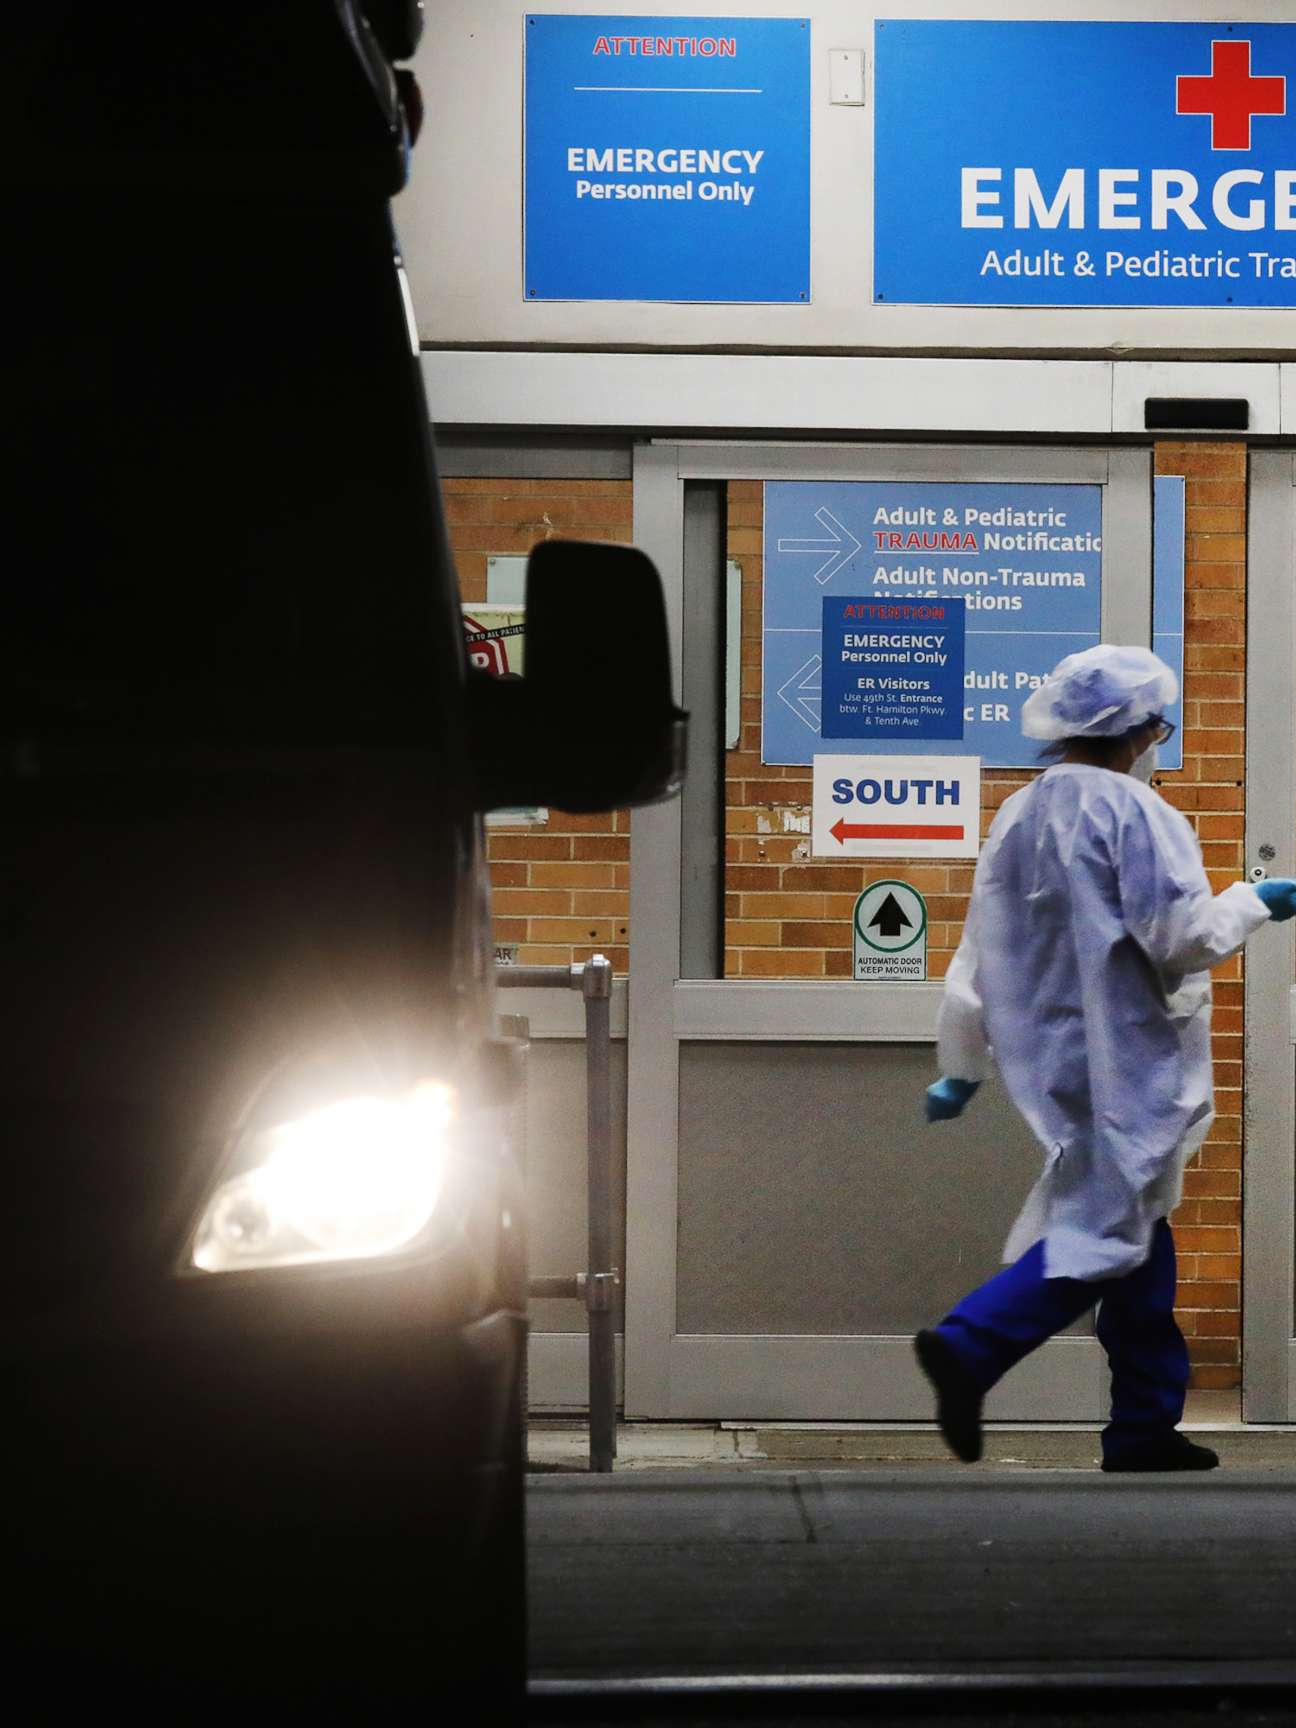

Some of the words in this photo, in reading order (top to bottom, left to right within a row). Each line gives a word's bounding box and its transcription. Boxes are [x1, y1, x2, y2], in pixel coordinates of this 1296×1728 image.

[592, 35, 737, 58] ATTENTION
[567, 147, 765, 174] EMERGENCY
[576, 179, 693, 200] Personnel
[698, 181, 755, 206] Only
[979, 248, 1065, 277] Adult
[1073, 250, 1096, 277] &
[1105, 249, 1241, 278] Pediatric
[872, 506, 937, 526] Adult
[942, 507, 959, 526] &
[964, 506, 1067, 527] Pediatric
[872, 530, 980, 552] TRAUMA
[872, 565, 937, 586] Adult
[942, 567, 1086, 587] Non-Trauma
[843, 604, 946, 621] ATTENTION
[844, 634, 945, 649] EMERGENCY
[841, 650, 911, 663] Personnel
[913, 651, 948, 666] Only
[857, 677, 876, 689] ER
[878, 677, 930, 690] Visitors
[844, 693, 862, 702] Use
[862, 692, 885, 704] 49th
[900, 693, 943, 704] Entrance
[875, 704, 919, 715] Hamilton
[980, 703, 1011, 722] ER
[864, 716, 872, 726] &
[873, 716, 901, 726] Tenth
[831, 778, 960, 806] SOUTH
[857, 957, 899, 965] AUTOMATIC
[900, 957, 923, 965] DOOR
[860, 965, 884, 974] KEEP
[885, 966, 920, 975] MOVING
